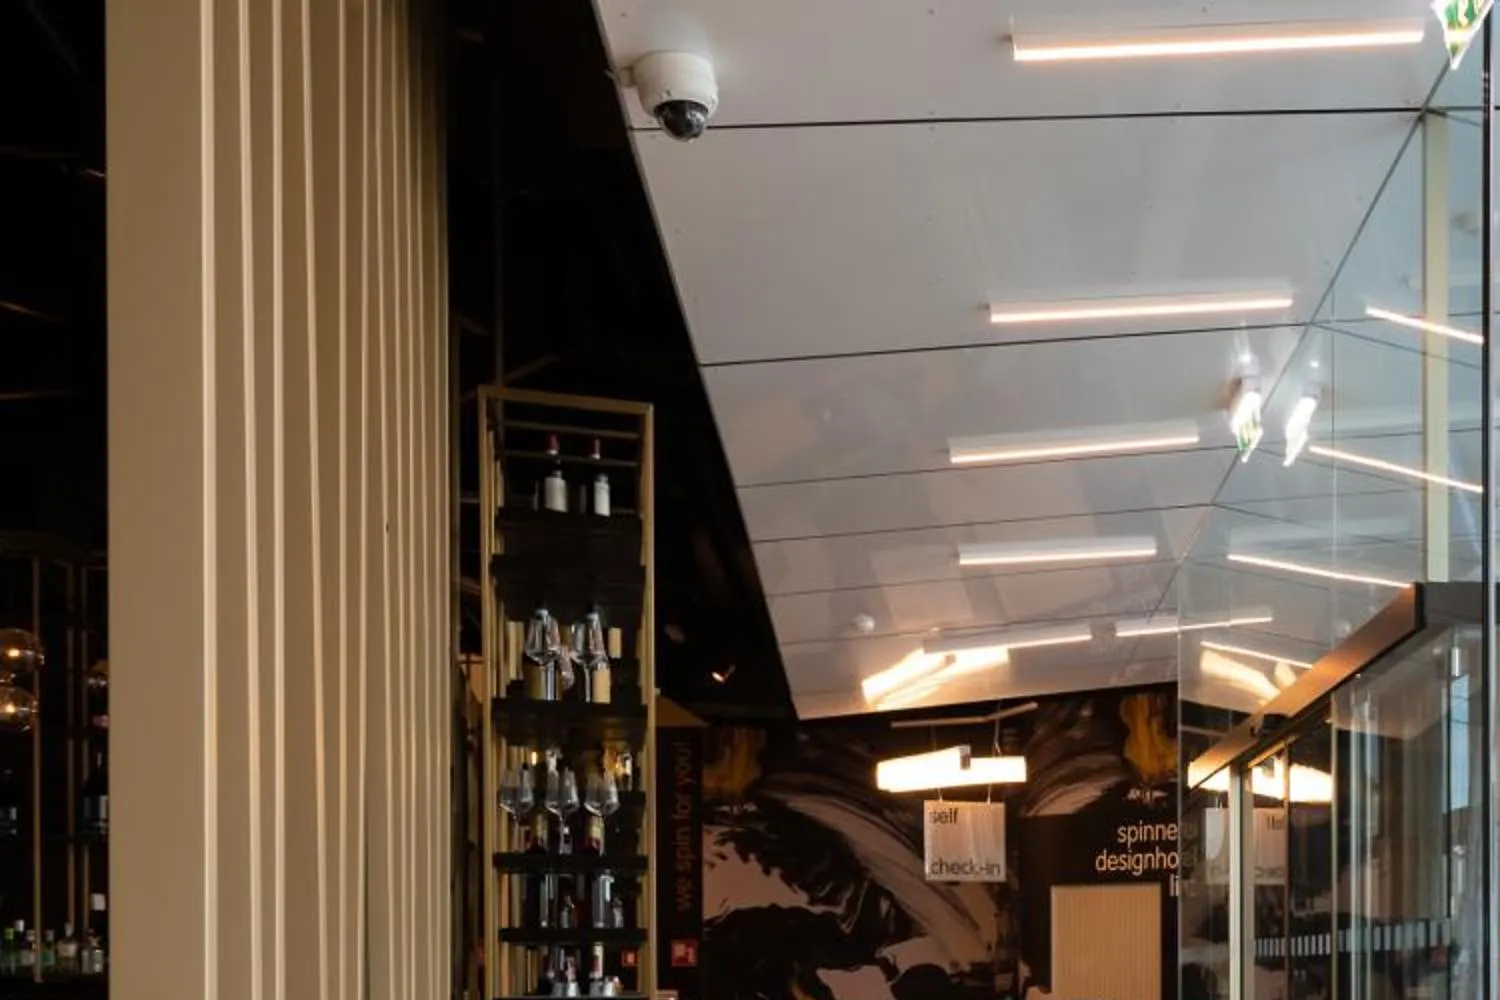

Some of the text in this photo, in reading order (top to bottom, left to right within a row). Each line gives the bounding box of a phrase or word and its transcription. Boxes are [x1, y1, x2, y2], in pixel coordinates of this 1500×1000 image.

[669, 741, 697, 787] you!
[671, 793, 692, 819] for
[929, 807, 959, 824] self
[1117, 819, 1196, 849] spinne
[671, 825, 696, 872] spin
[931, 857, 1000, 875] check-in
